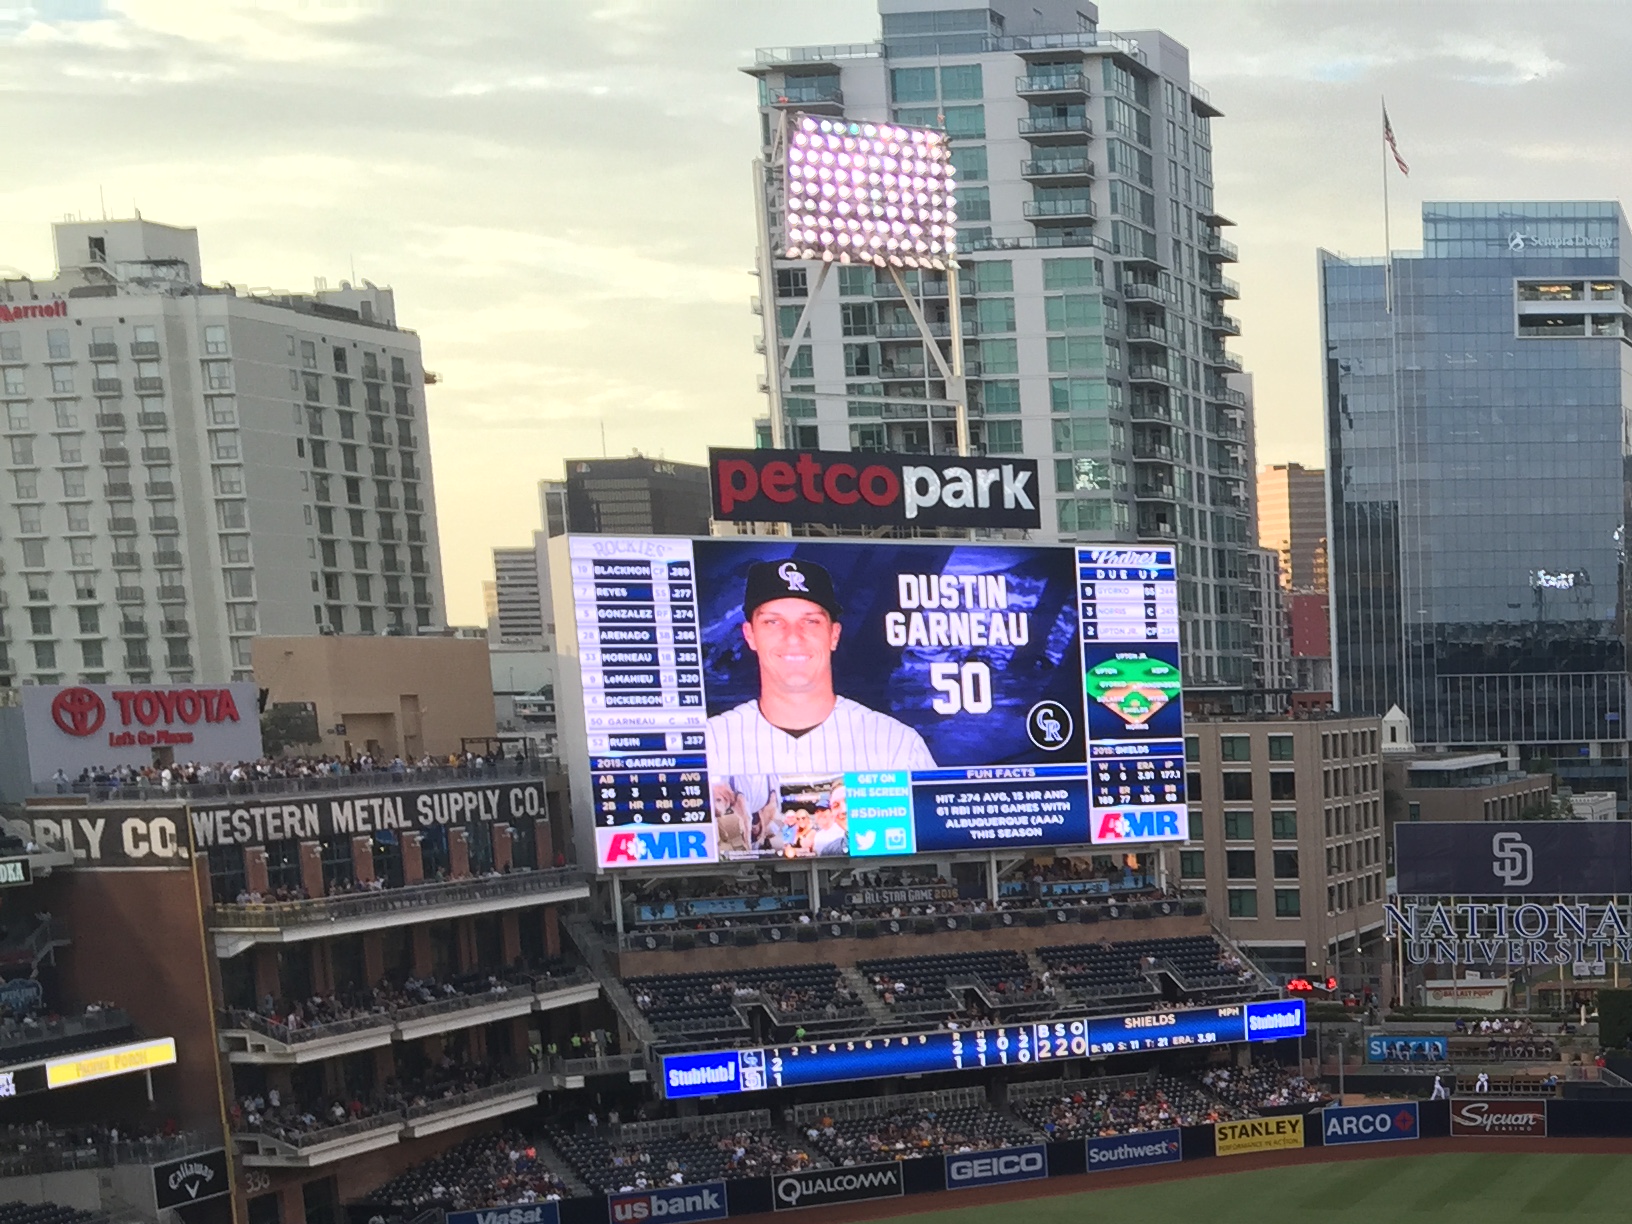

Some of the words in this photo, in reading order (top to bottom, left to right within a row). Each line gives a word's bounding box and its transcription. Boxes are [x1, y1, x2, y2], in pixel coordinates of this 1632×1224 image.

[1530, 235, 1574, 248] Sempra
[1575, 235, 1613, 248] Energy
[593, 540, 666, 558] ROCKIES
[594, 566, 651, 576] BLACKMON
[1096, 569, 1127, 579] DUE
[1138, 569, 1158, 579] UP
[596, 588, 628, 597] REYES
[897, 574, 1008, 609] DUSTIN
[598, 609, 653, 619] GONZALEZ
[600, 631, 650, 640] ARENADO
[885, 612, 1029, 647] GARNEAU
[602, 653, 652, 662] MORNEAU
[930, 661, 992, 714] 50
[111, 689, 240, 726] TOYOTA
[606, 696, 661, 705] DICKERSON
[138, 731, 155, 745] Go
[610, 738, 640, 747] RUSIN
[597, 759, 624, 768] 2015:
[625, 758, 676, 767] GARNEAU
[858, 774, 878, 784] GET
[881, 773, 896, 783] ON
[966, 768, 992, 779] FUN
[995, 767, 1035, 778] FACTS
[848, 788, 867, 798] THE
[869, 787, 908, 797] SCREEN
[935, 794, 955, 804] HIT
[957, 793, 981, 803] .274
[983, 791, 1010, 802] AVG,
[1012, 791, 1024, 801] 15
[1026, 791, 1041, 800] HR
[1043, 790, 1068, 799] AND
[851, 807, 907, 819] #SDinHD
[936, 806, 949, 816] 61
[951, 805, 970, 815] RBI
[973, 805, 984, 814] IN
[987, 804, 999, 814] 81
[1001, 803, 1039, 813] GAMES
[1041, 802, 1070, 812] WITH
[191, 803, 320, 847] WESTERN
[331, 796, 412, 834] METAL
[417, 789, 500, 824] SUPPLY
[510, 787, 545, 818] CO.
[946, 817, 1028, 828] ALBUQUERQUE
[1031, 815, 1064, 825] (AAA)
[121, 817, 190, 859] CO.
[970, 829, 995, 839] THIS
[997, 828, 1042, 838] SEASON
[1493, 832, 1534, 887] SD
[908, 889, 933, 902] GAME
[934, 888, 958, 899] 2016
[1473, 989, 1494, 998] POINT
[1218, 1008, 1239, 1017] MPH
[1250, 1009, 1300, 1030] StubHub!
[1124, 1014, 1176, 1029] SHIELDS
[1038, 1025, 1049, 1038] B
[1055, 1023, 1066, 1037] S
[1070, 1021, 1083, 1035] O
[669, 1062, 735, 1086] StubHub!
[1460, 1102, 1537, 1131] Sycuan
[1218, 1119, 1300, 1141] STANLEY
[1326, 1113, 1391, 1136] ARCO
[1089, 1139, 1169, 1163] Southwest
[1219, 1141, 1262, 1151] PERFORMANCE
[951, 1152, 1043, 1180] GEICO
[168, 1162, 215, 1190] Callaway
[777, 1169, 898, 1205] QUALCOMM
